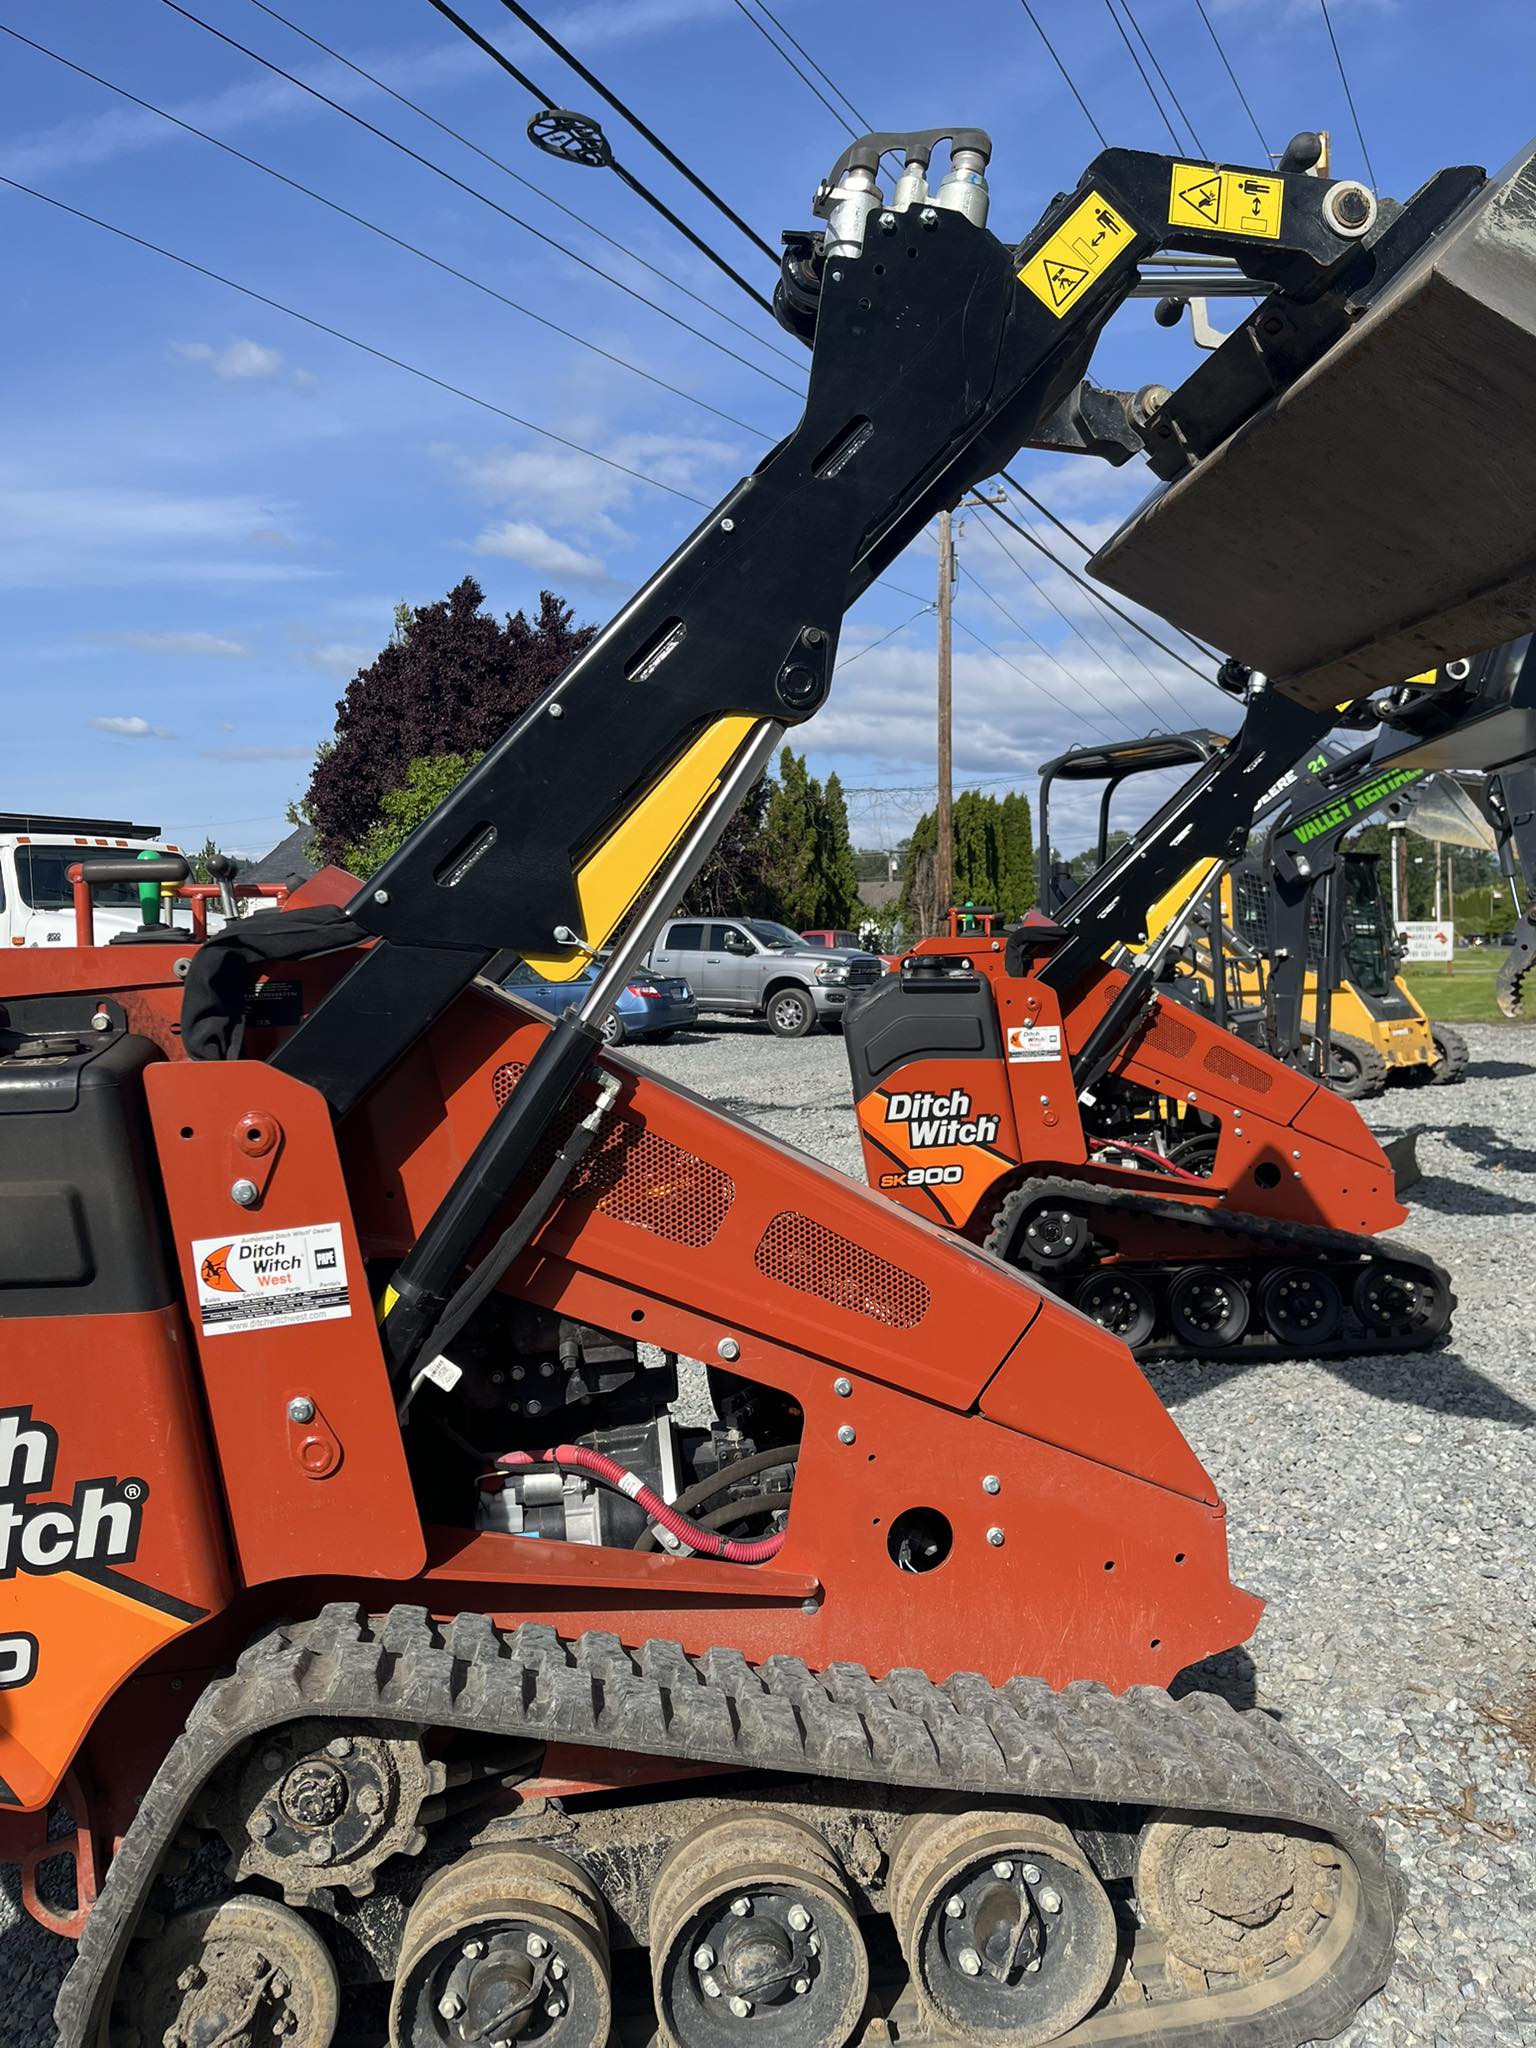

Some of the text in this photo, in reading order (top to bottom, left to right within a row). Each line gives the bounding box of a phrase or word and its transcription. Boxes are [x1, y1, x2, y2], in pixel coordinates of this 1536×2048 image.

[1307, 754, 1328, 775] 21
[1293, 797, 1352, 845] VALLEY
[887, 1090, 970, 1121] Ditch
[910, 1116, 997, 1147] Witch
[880, 1166, 962, 1187] SK900
[239, 1241, 285, 1260] Ditch
[253, 1255, 301, 1274] Witch
[257, 1273, 292, 1287] West
